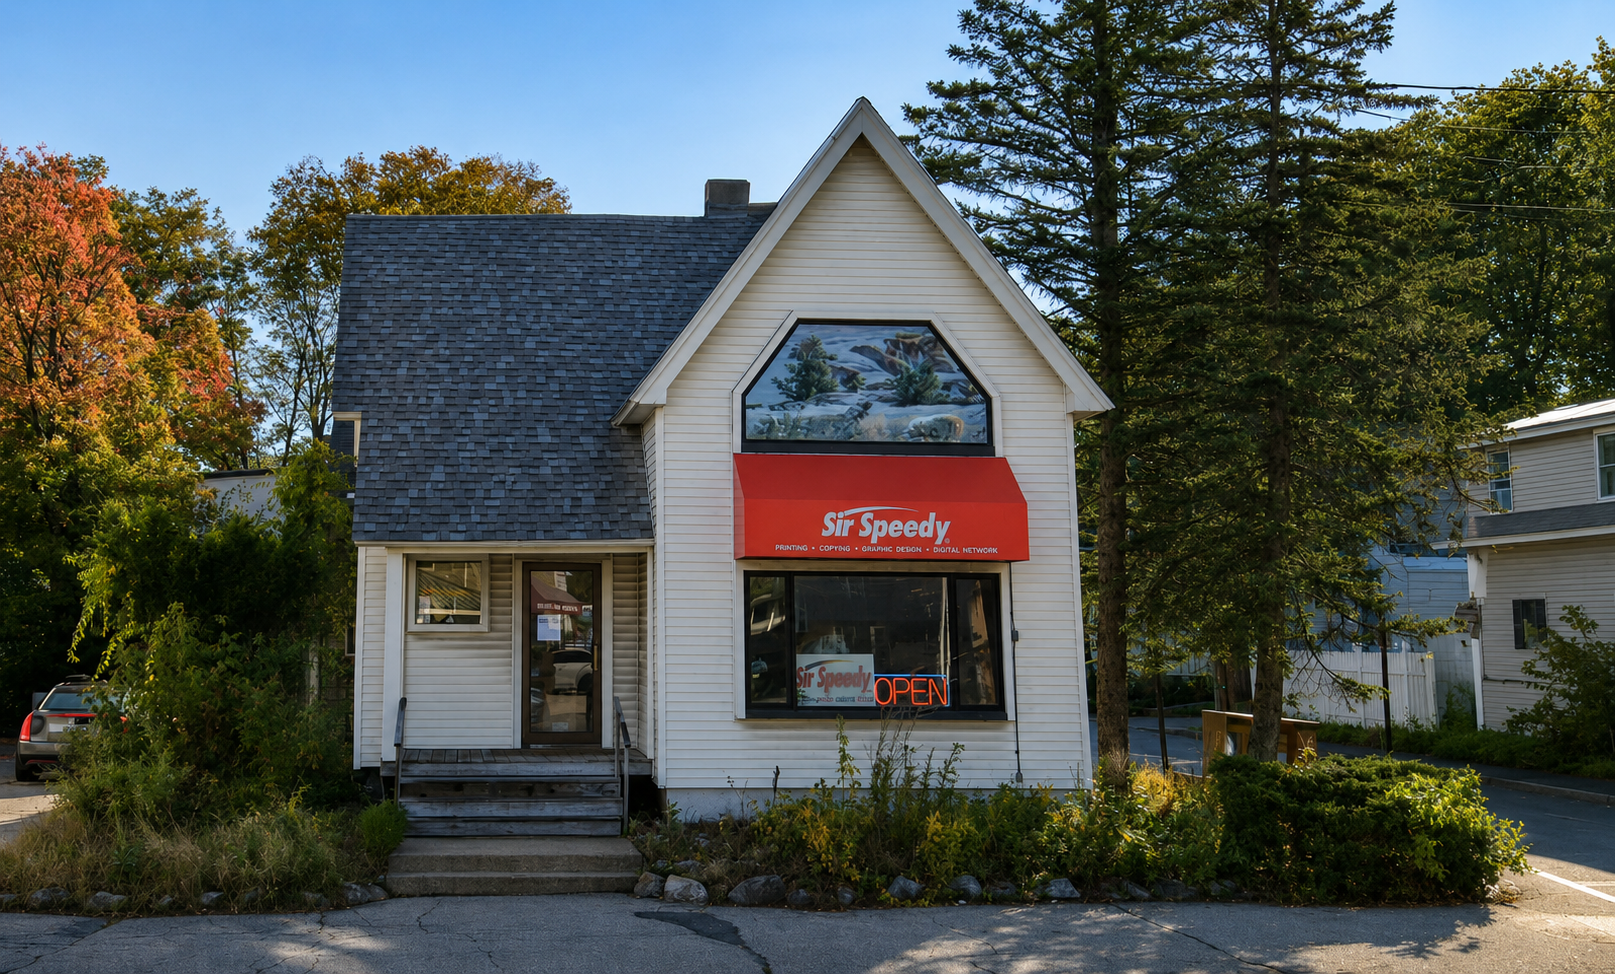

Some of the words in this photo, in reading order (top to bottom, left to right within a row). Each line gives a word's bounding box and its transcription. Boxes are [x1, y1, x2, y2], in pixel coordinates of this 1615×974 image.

[821, 511, 854, 537] Sir
[858, 512, 951, 545] Speedy
[861, 545, 893, 553] GRAPHIC
[796, 666, 815, 688] Sir
[817, 665, 872, 693] Speedy
[874, 677, 948, 706] OPEN
